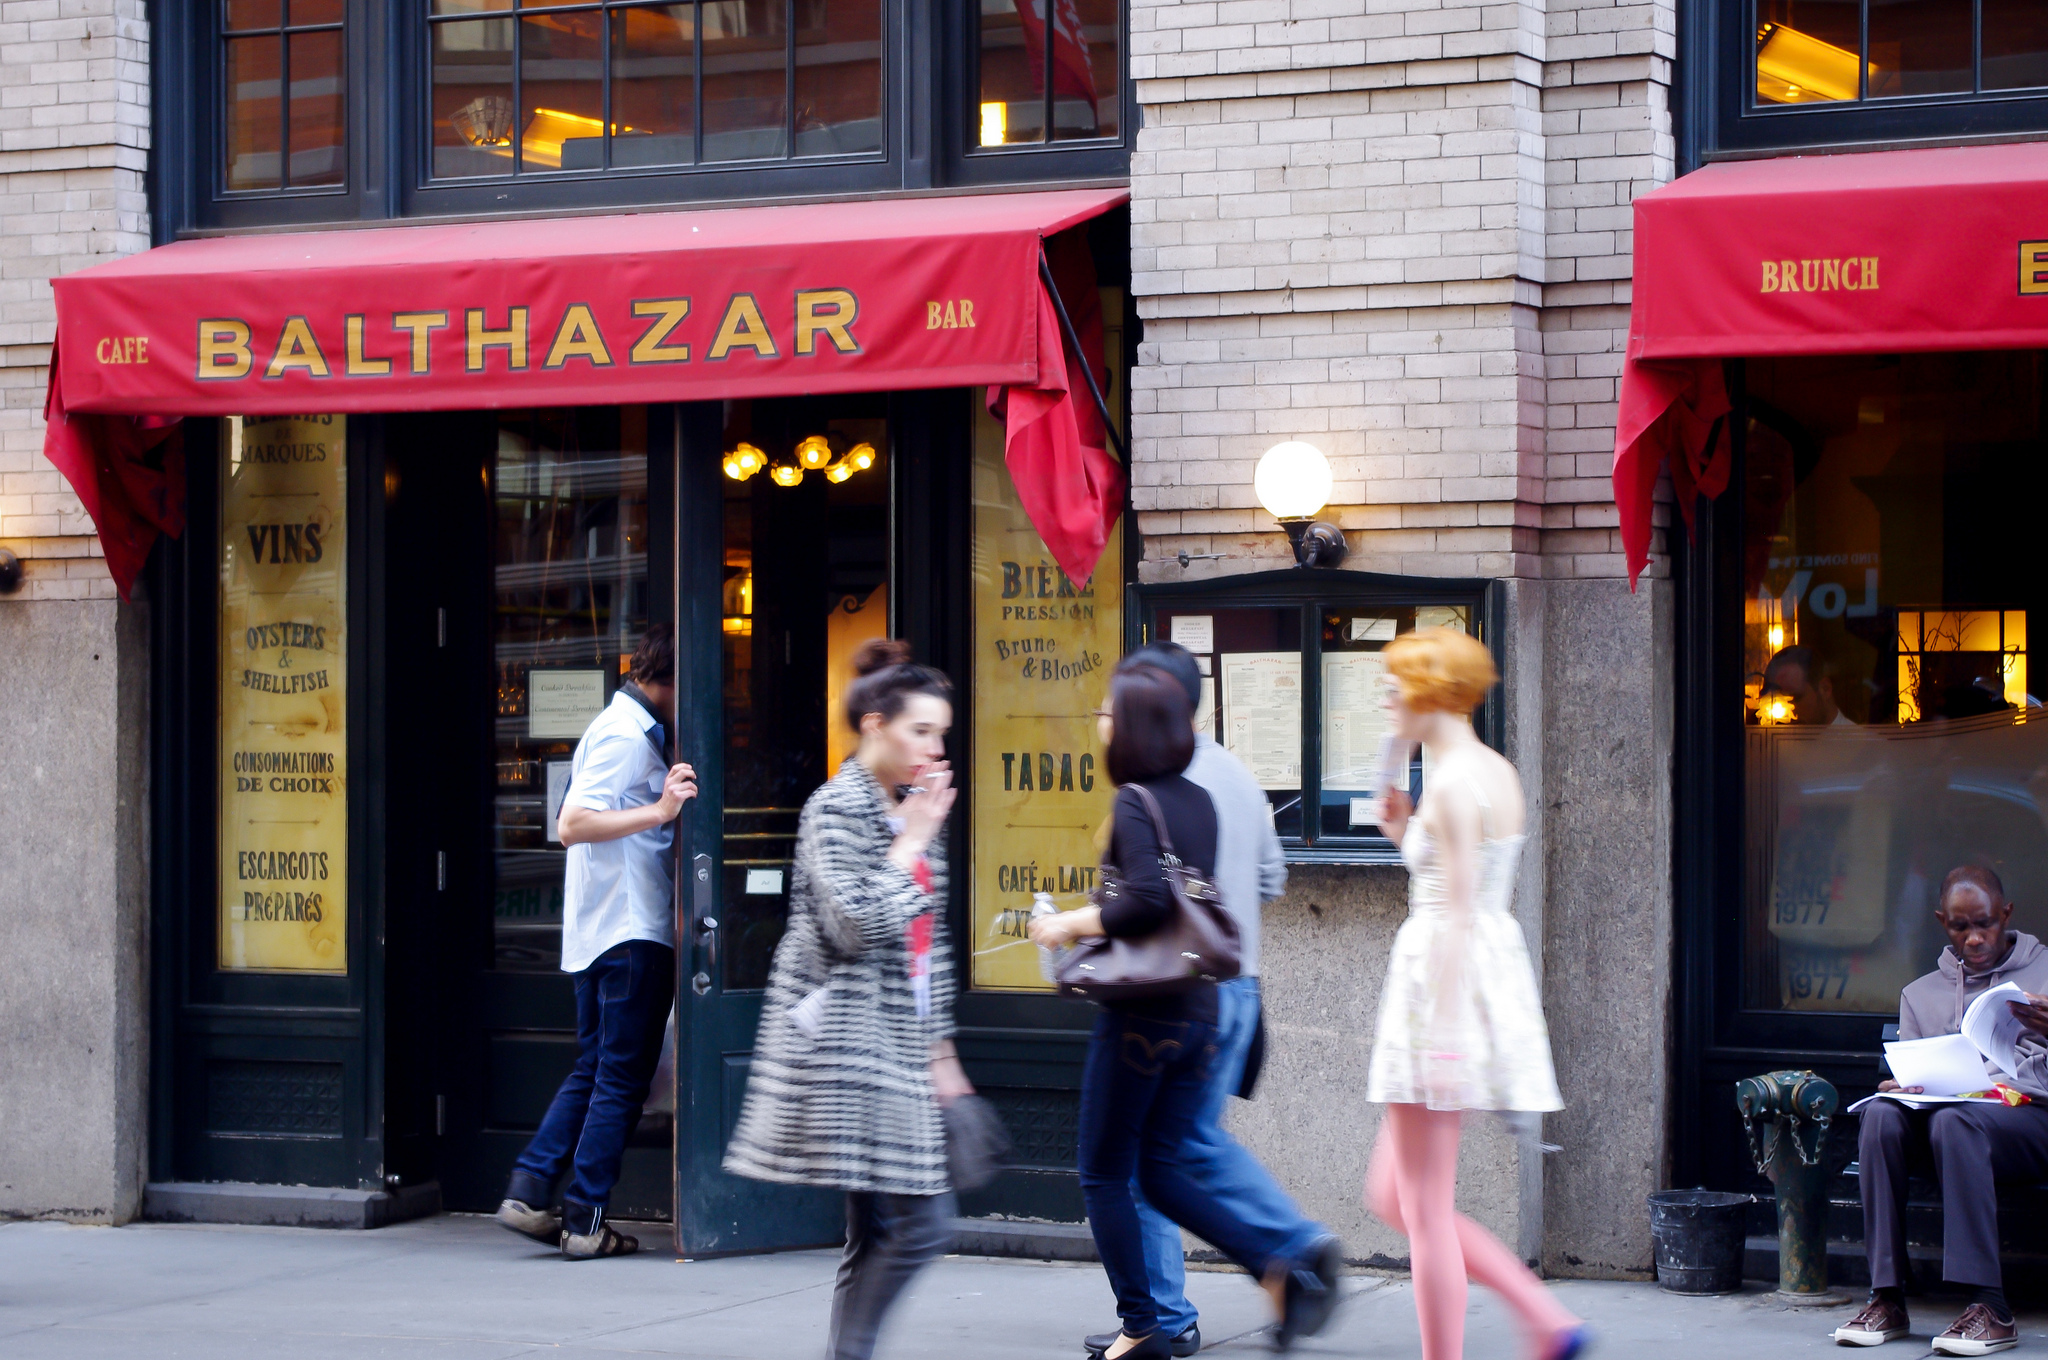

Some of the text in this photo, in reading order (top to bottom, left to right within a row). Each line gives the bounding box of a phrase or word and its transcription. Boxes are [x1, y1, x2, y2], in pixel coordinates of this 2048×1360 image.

[1760, 257, 1879, 293] BRUNCH
[926, 300, 976, 330] BAR
[195, 287, 865, 382] BALTHAZAR
[97, 337, 149, 364] CAFE
[241, 443, 327, 464] MARQUES
[247, 523, 323, 564] VINS
[1002, 605, 1094, 621] PRESSION
[247, 621, 326, 650] OYSTERS
[994, 637, 1056, 660] Brune
[278, 649, 292, 668] &
[1022, 650, 1102, 681] & Blonde
[241, 669, 329, 694] SHELLFISH
[234, 751, 334, 773] CONSOMMATIONS
[1002, 753, 1094, 793] TABAC
[237, 777, 331, 793] DE CHOIX
[238, 851, 329, 880] ESCARGOTS
[998, 861, 1096, 893] CAFÉ AU LAIT
[1776, 902, 1830, 925] 1977
[1789, 974, 1849, 1000] 1977
